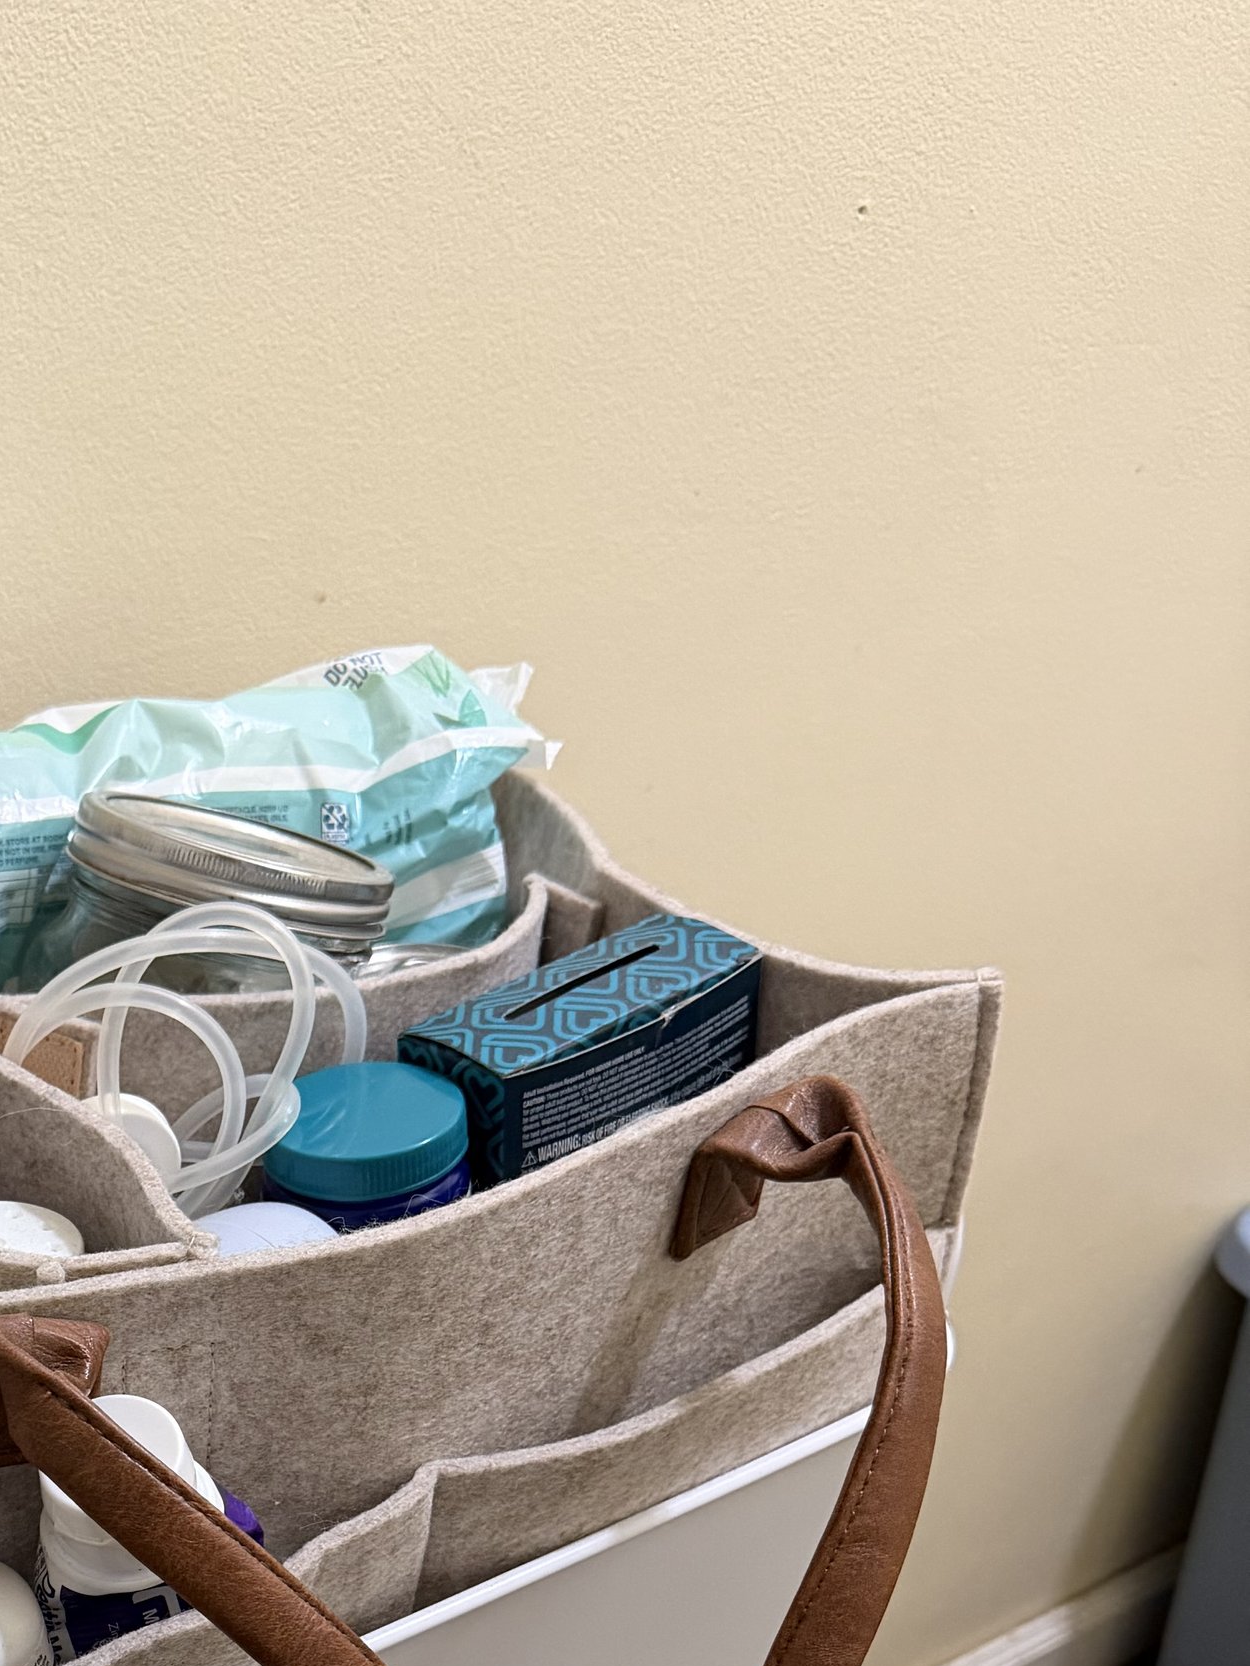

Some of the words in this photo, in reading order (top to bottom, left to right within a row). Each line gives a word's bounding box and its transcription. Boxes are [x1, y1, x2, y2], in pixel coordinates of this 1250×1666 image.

[323, 662, 348, 688] DO
[350, 651, 383, 666] NOT
[538, 1133, 582, 1163] WARNING:
[581, 1130, 596, 1145] RISK
[595, 1125, 605, 1140] OF
[604, 1120, 618, 1137] FIRE
